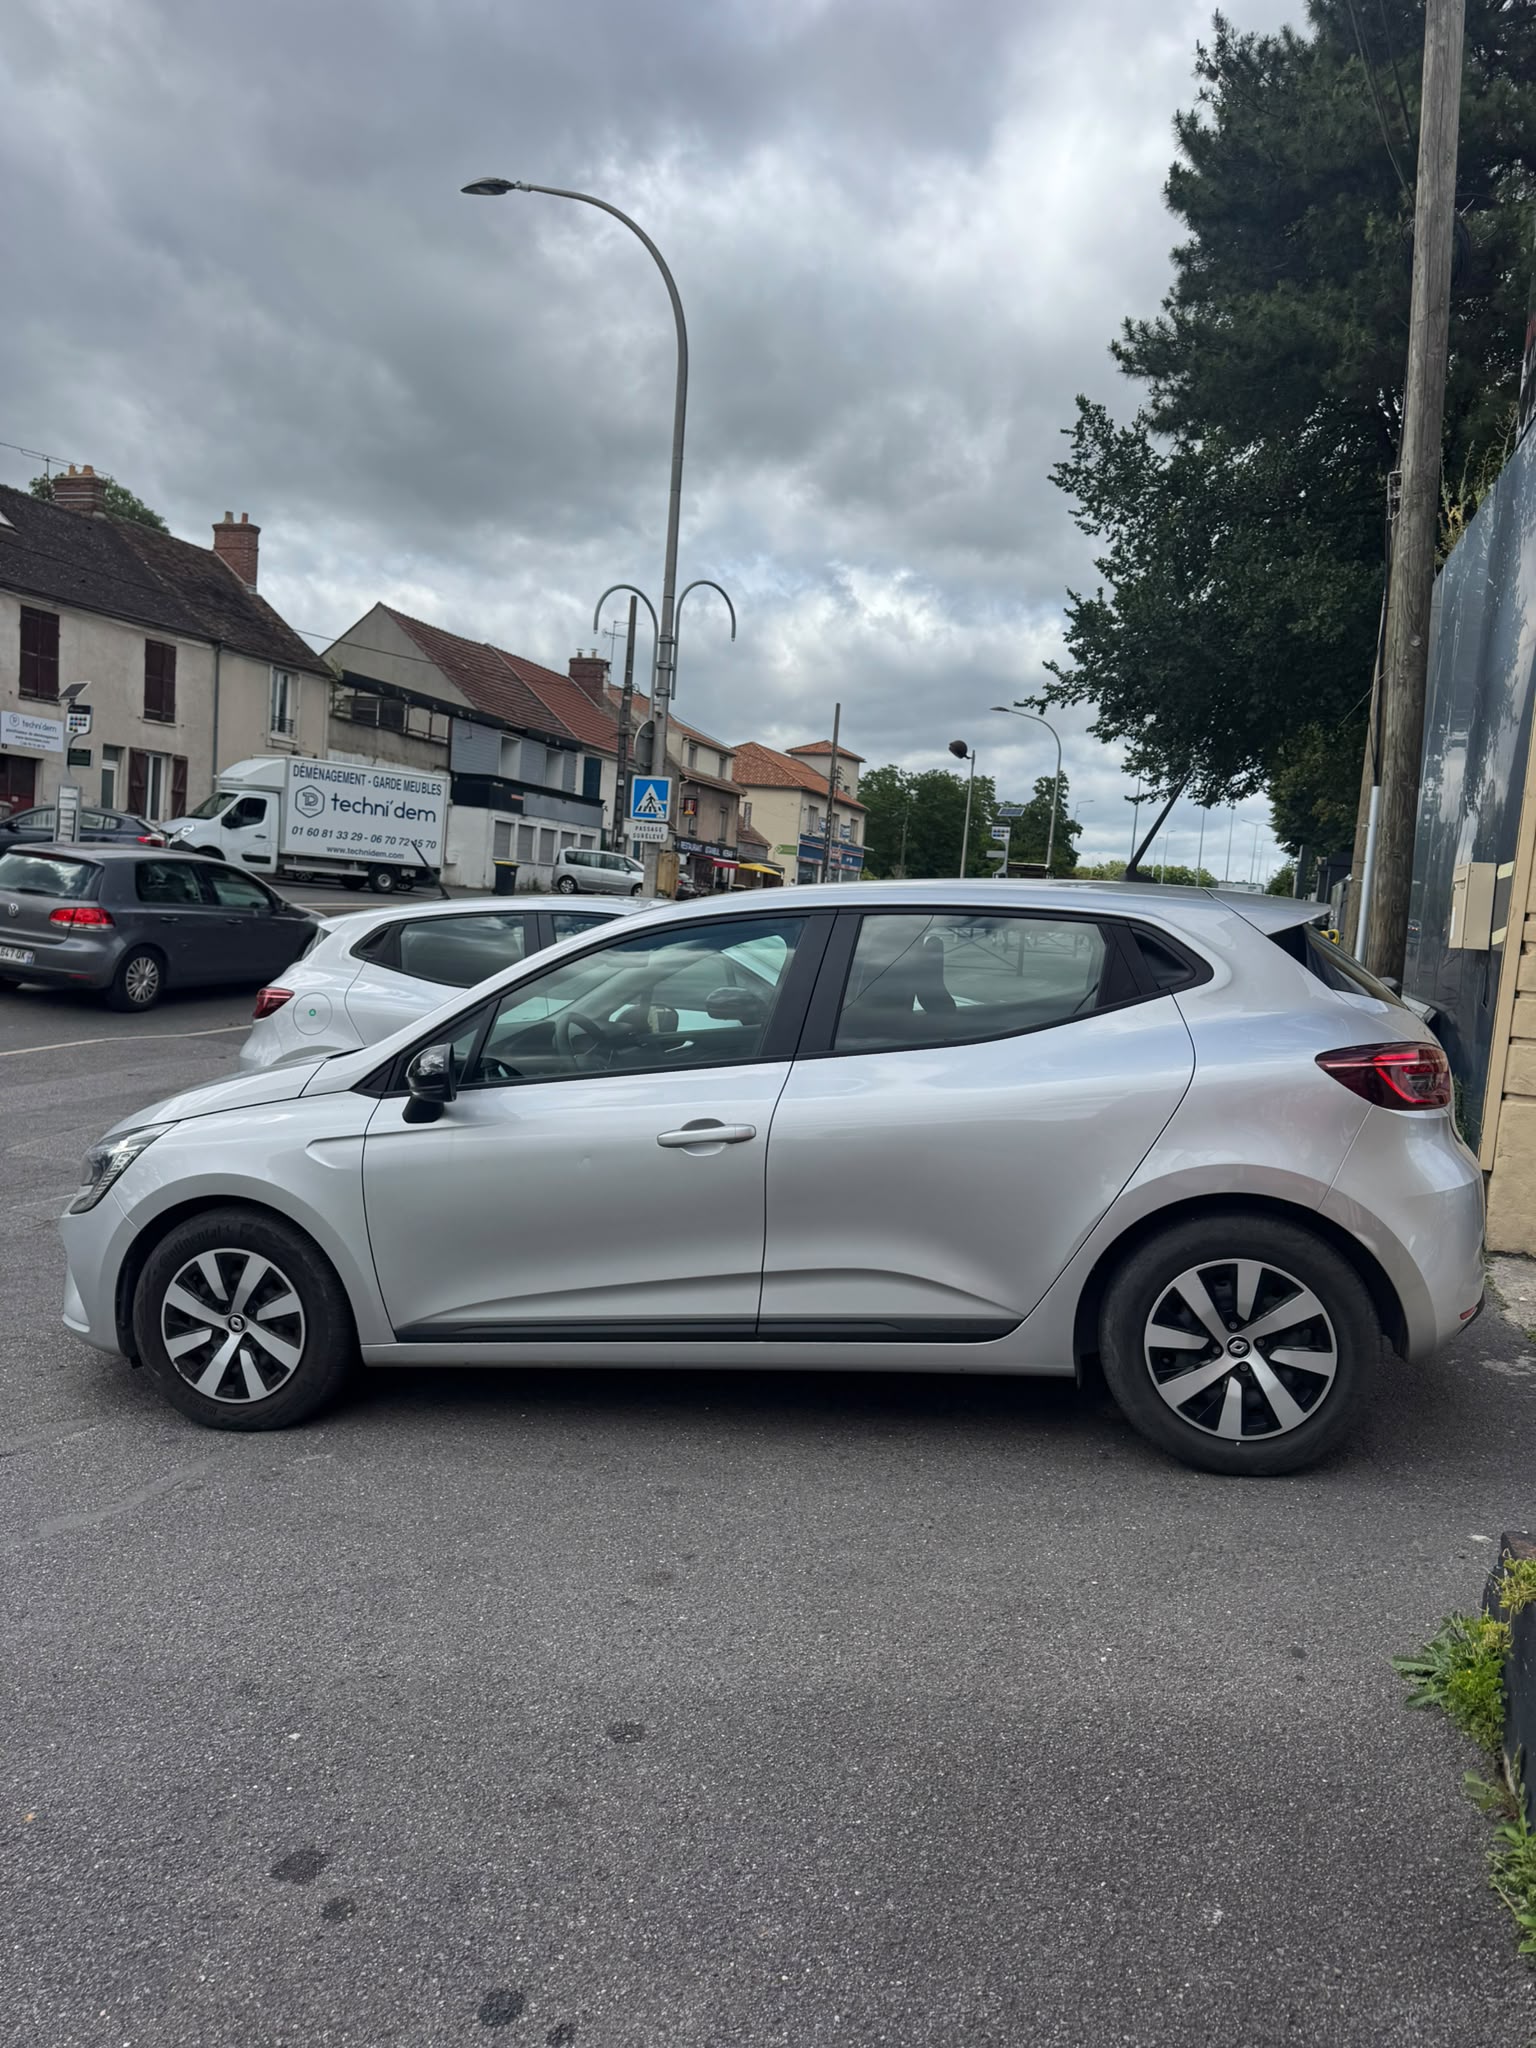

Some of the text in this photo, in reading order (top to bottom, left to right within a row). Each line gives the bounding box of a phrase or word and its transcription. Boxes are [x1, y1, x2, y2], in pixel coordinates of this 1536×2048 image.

[293, 762, 366, 786] DÉMÉNAGEMENT
[373, 776, 402, 791] GARDE
[403, 779, 442, 796] MEUBLES
[331, 793, 436, 823] techni'dem
[291, 826, 304, 836] 01
[306, 827, 319, 837] 60
[321, 829, 333, 839] 81
[336, 830, 349, 840] 33
[350, 832, 363, 842] 29
[370, 834, 382, 844] 06
[385, 835, 397, 846] 70
[398, 837, 410, 847] 72
[425, 840, 437, 849] 70
[635, 825, 663, 833] PASSAGE
[326, 846, 404, 859] www.technidem.com
